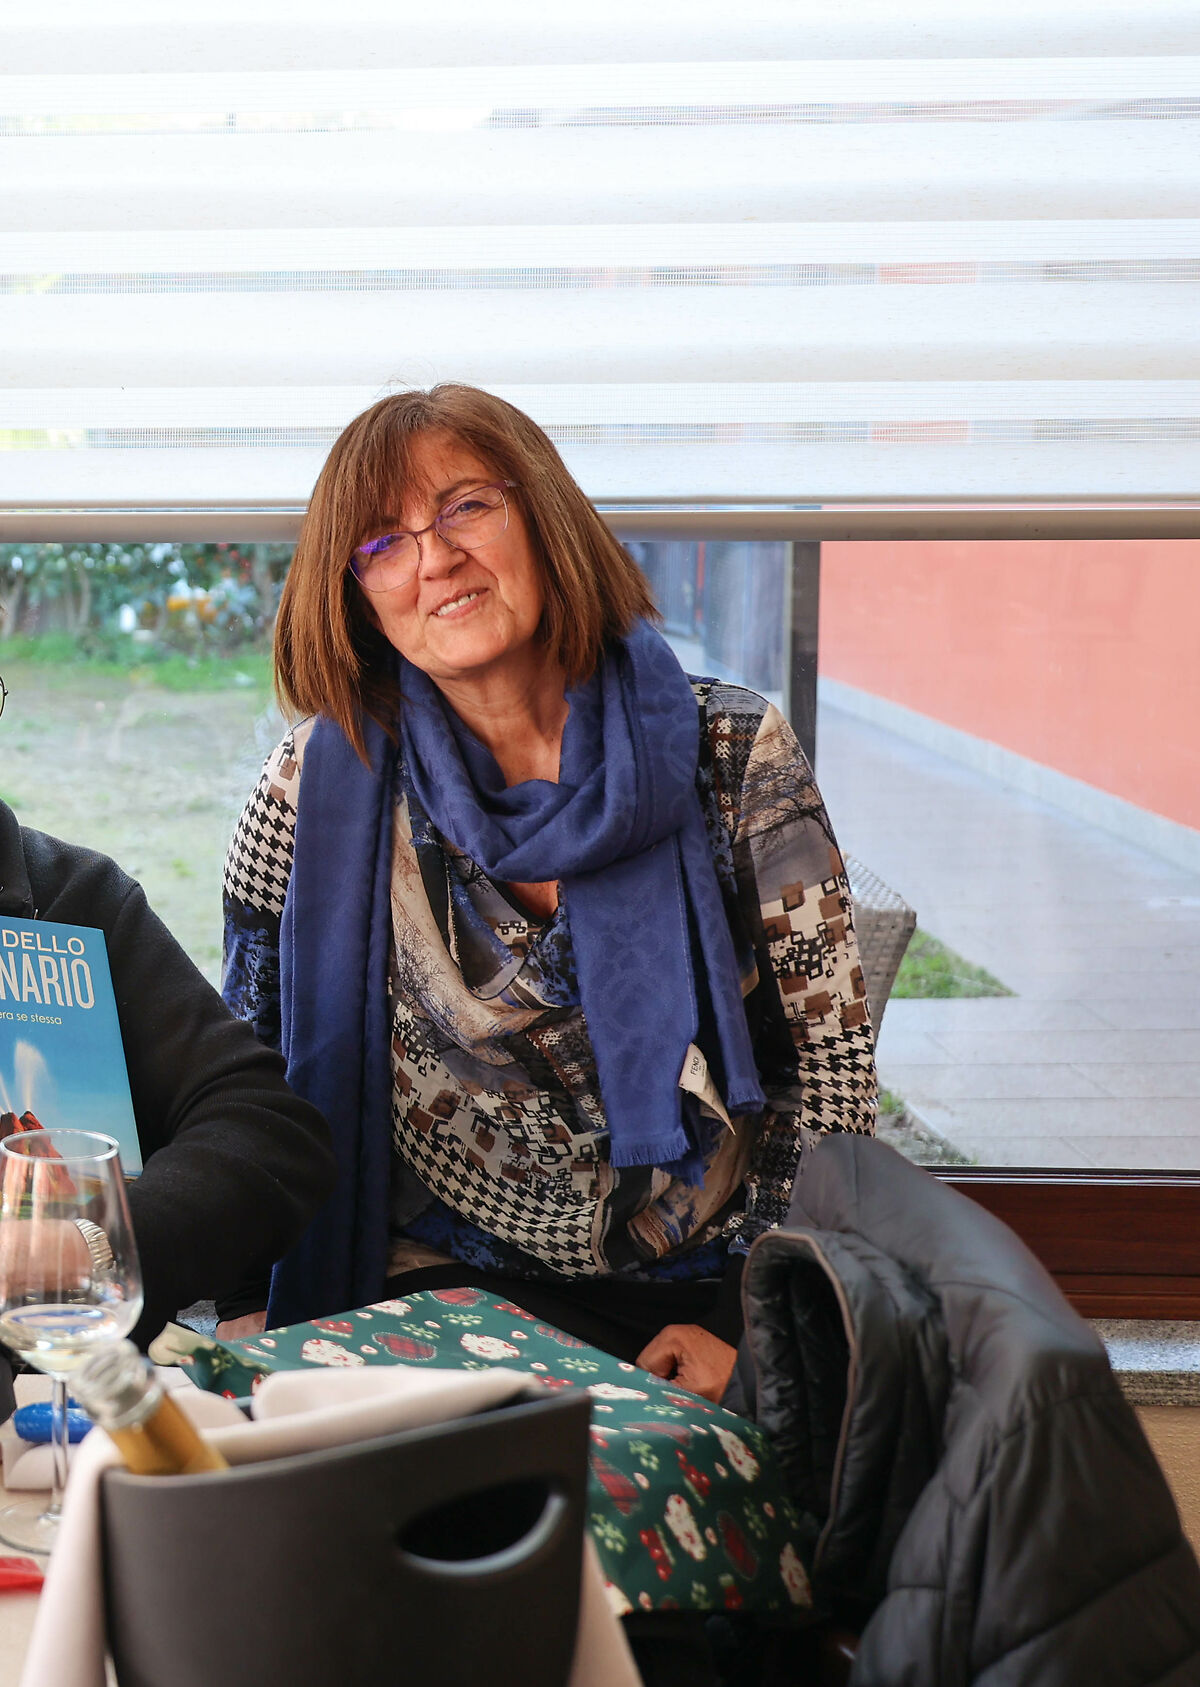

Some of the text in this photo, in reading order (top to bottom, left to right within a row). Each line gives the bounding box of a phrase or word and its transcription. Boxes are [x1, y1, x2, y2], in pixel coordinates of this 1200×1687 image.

[2, 929, 85, 956] DELLO
[16, 1013, 28, 1022] se
[31, 1014, 63, 1025] stessa
[690, 1056, 701, 1076] FENDI
